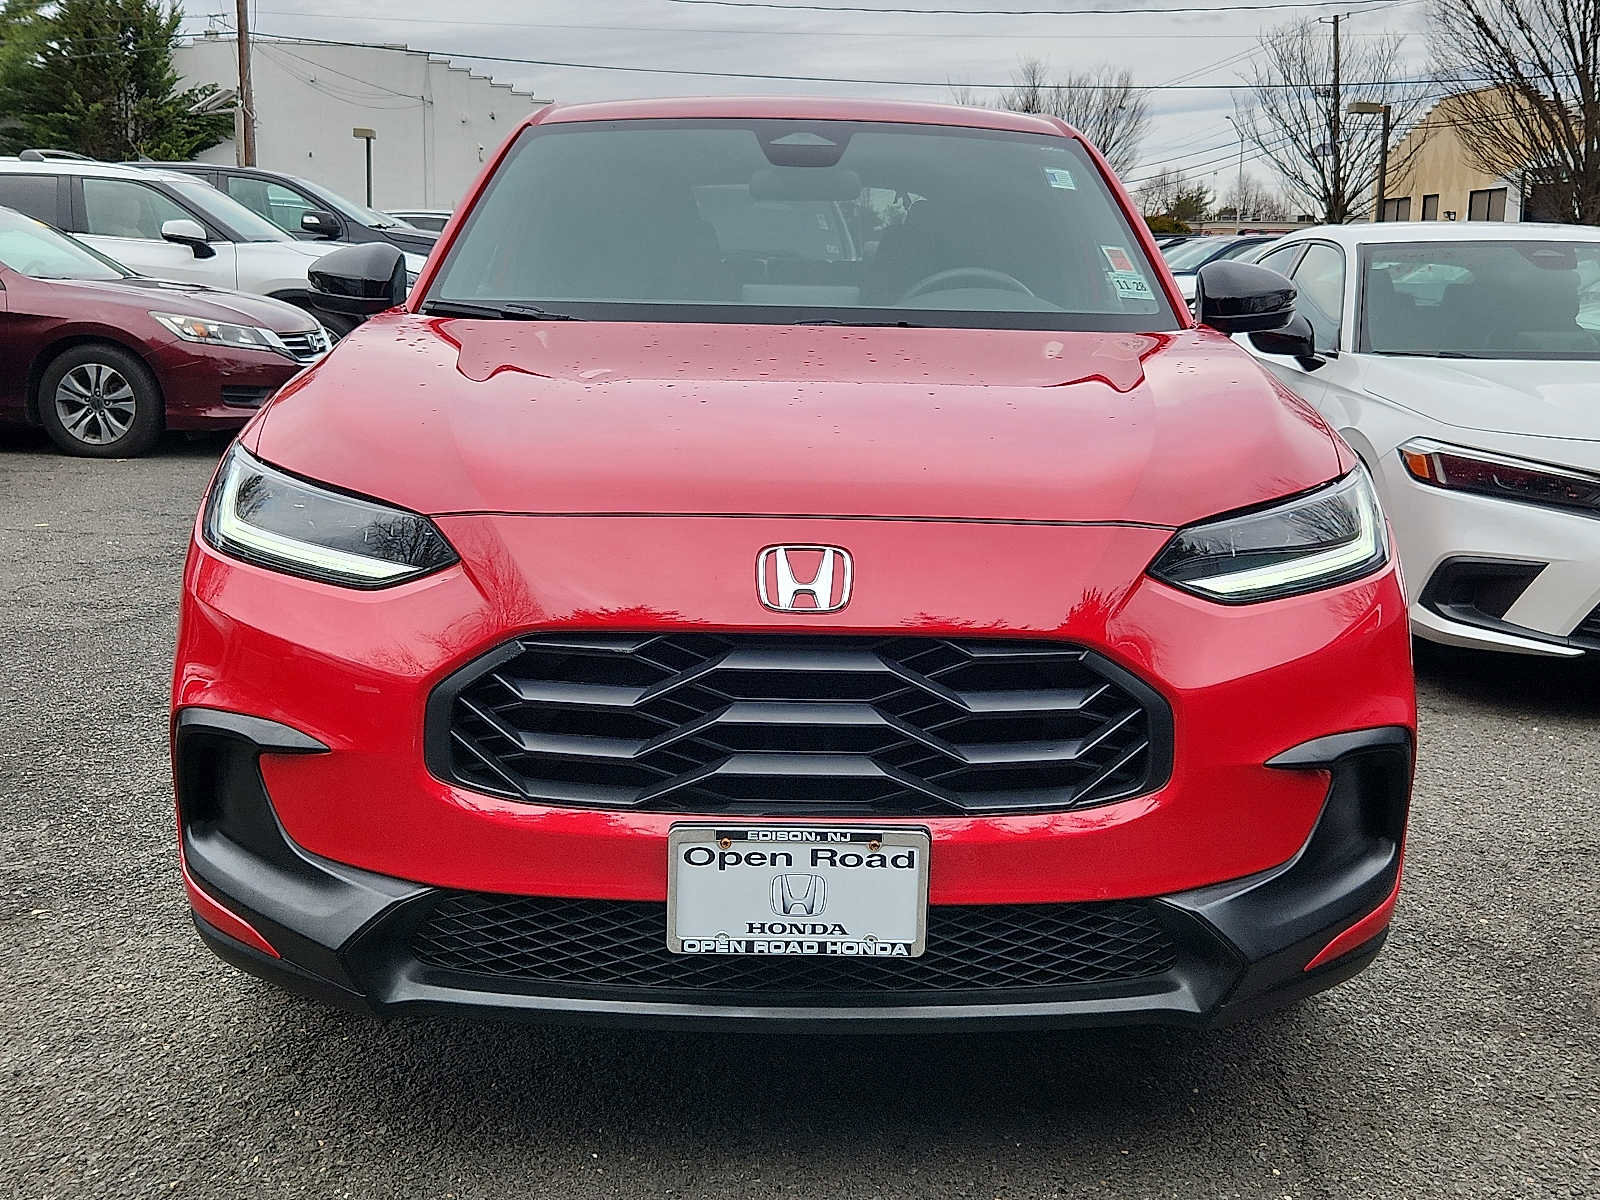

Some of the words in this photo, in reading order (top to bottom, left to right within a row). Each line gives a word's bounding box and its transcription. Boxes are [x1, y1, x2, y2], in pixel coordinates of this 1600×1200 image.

[748, 831, 821, 842] EDISON,
[828, 832, 851, 842] NJ
[683, 847, 793, 871] Open
[811, 849, 915, 869] Road
[746, 922, 849, 935] HONDA
[683, 940, 746, 953] OPEN
[753, 941, 819, 954] ROAD
[826, 942, 909, 956] HONDA
